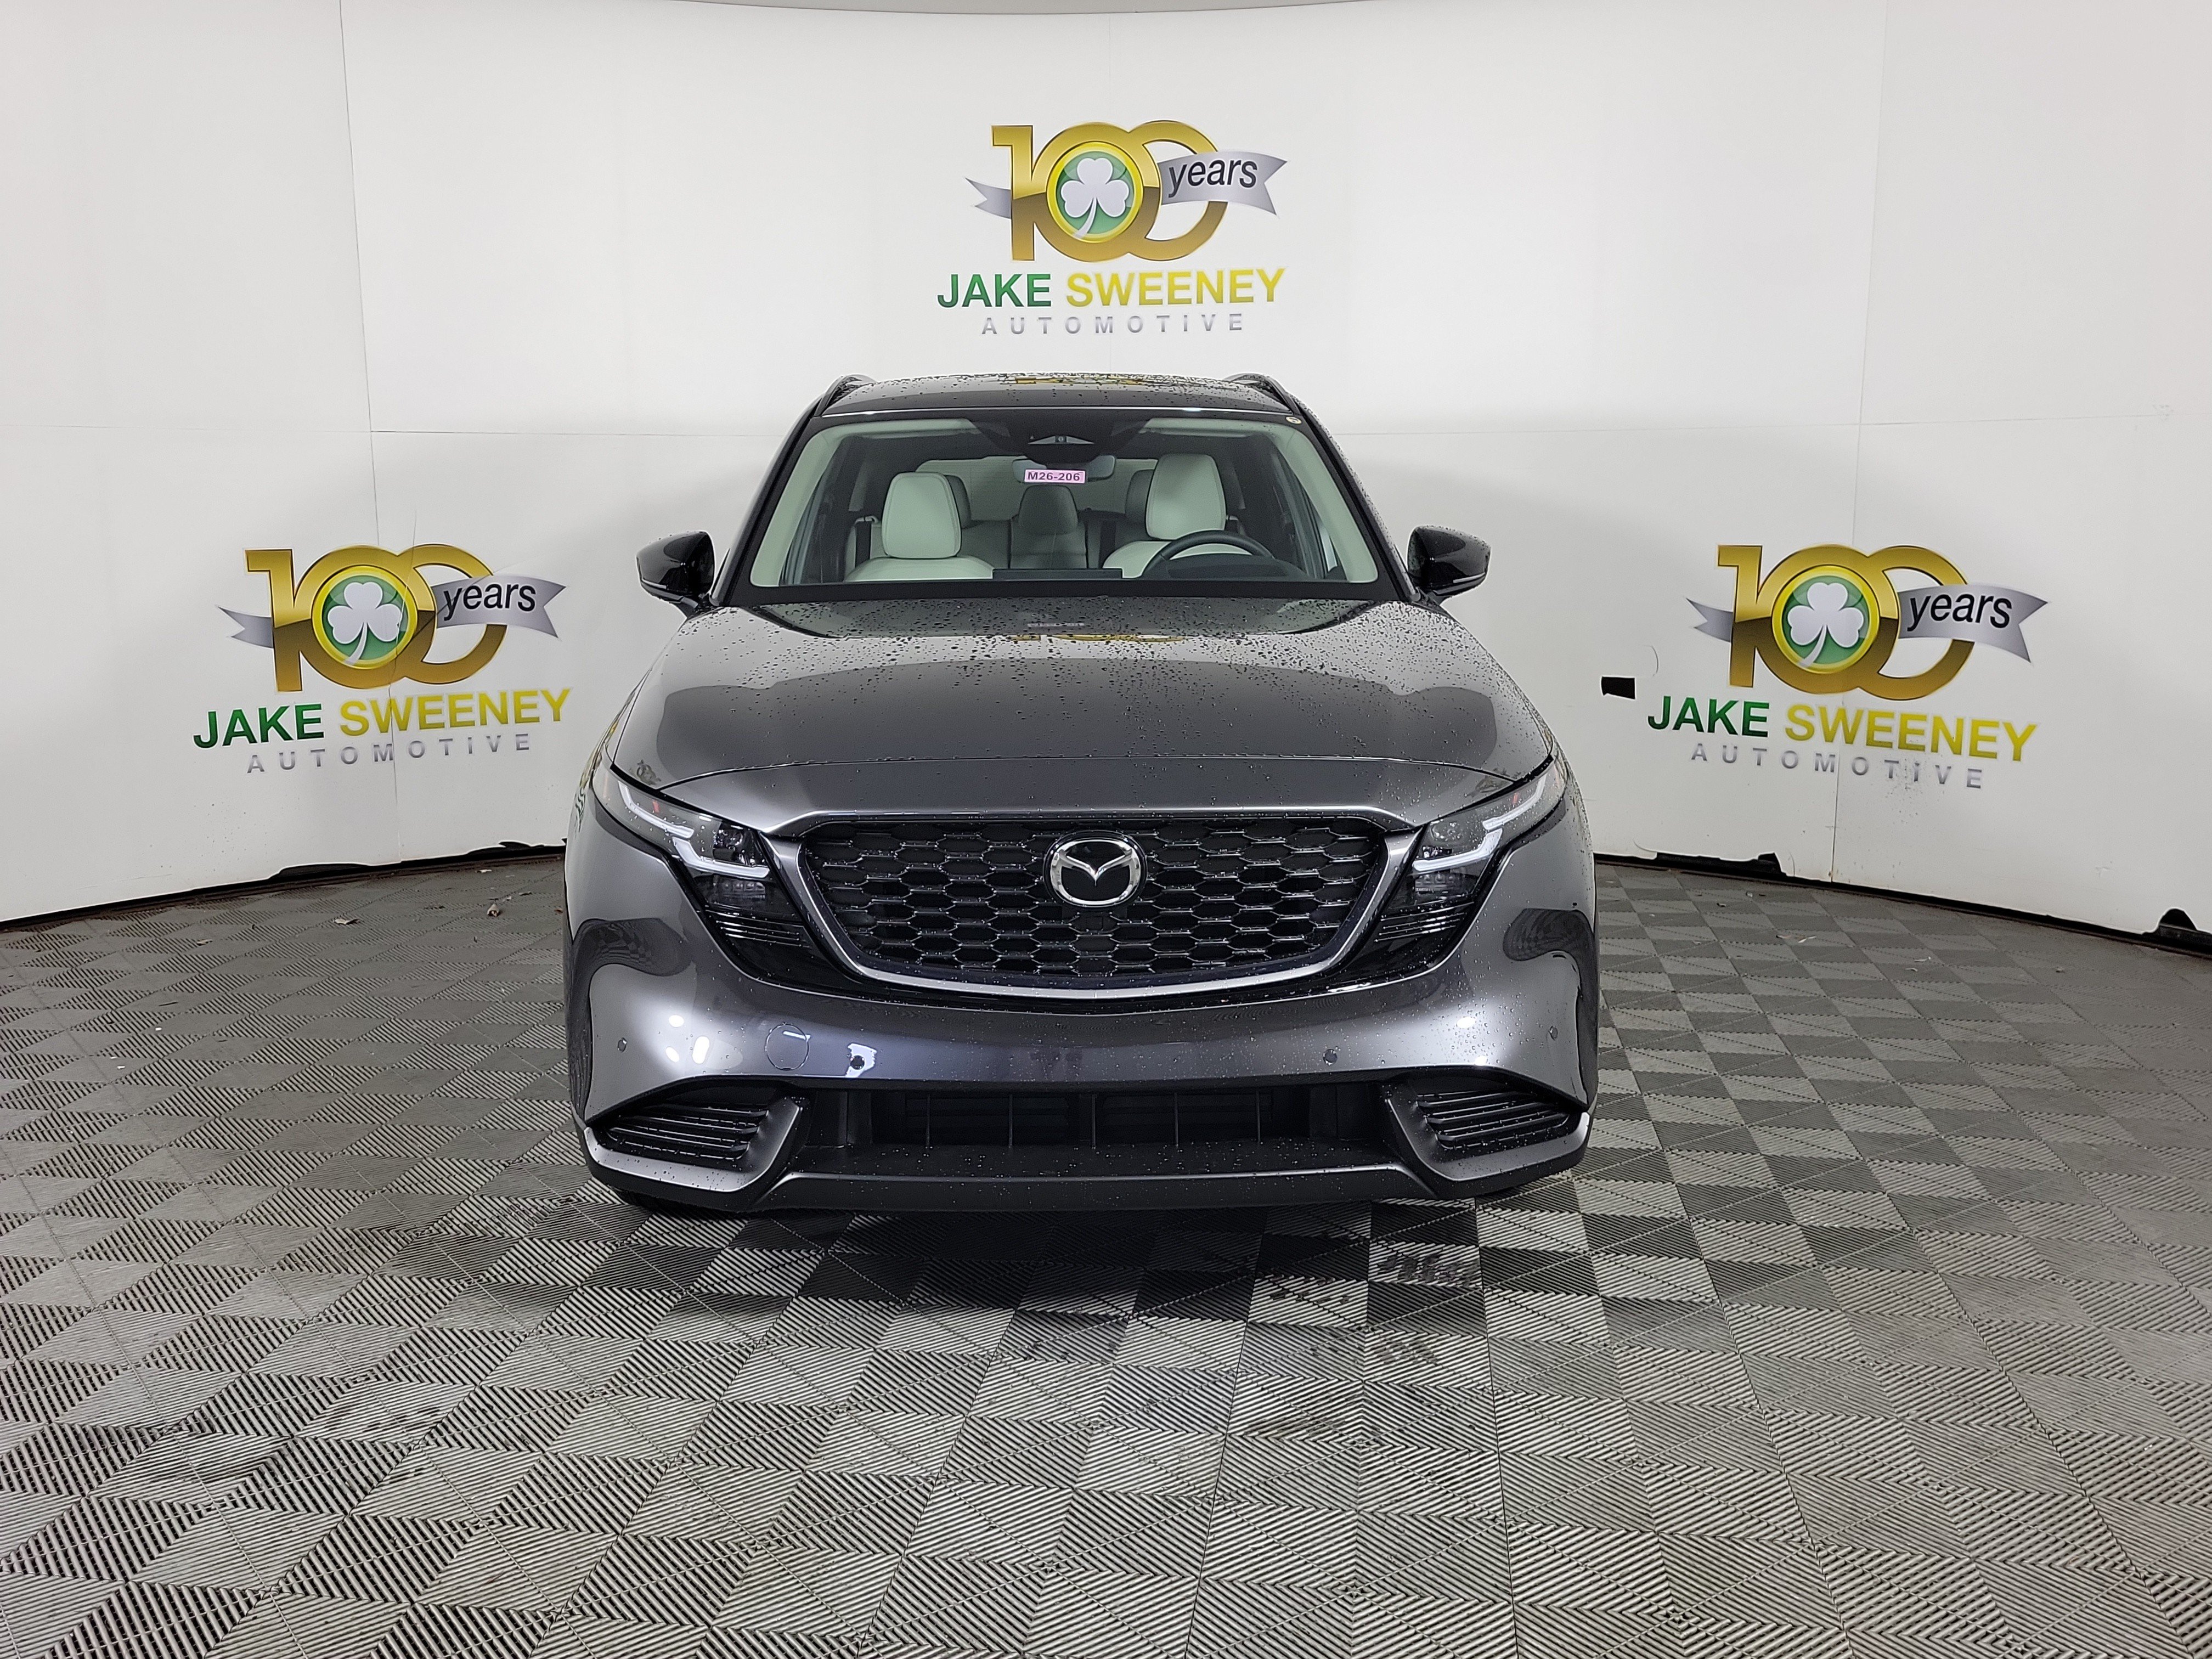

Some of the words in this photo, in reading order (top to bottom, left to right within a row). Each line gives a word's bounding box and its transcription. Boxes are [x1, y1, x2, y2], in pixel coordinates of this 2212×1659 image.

[991, 120, 1228, 263] 100
[1167, 160, 1257, 199] years
[938, 273, 1051, 307] JAKE
[1066, 268, 1285, 307] SWEENEY
[981, 313, 1243, 334] AUTOMOTIVE
[1028, 472, 1080, 481] M26-206
[245, 544, 507, 692] 100
[443, 583, 536, 620] years
[1718, 544, 1975, 701] 100
[1907, 593, 2012, 631] years
[193, 703, 324, 748] JAKE
[340, 689, 571, 736] SWEENEY
[1648, 696, 1769, 737] JAKE
[1785, 704, 2036, 761] SWEENEY
[247, 734, 529, 774] AUTOMOTIVE
[1691, 743, 1983, 789] AUTOMOTIVE
